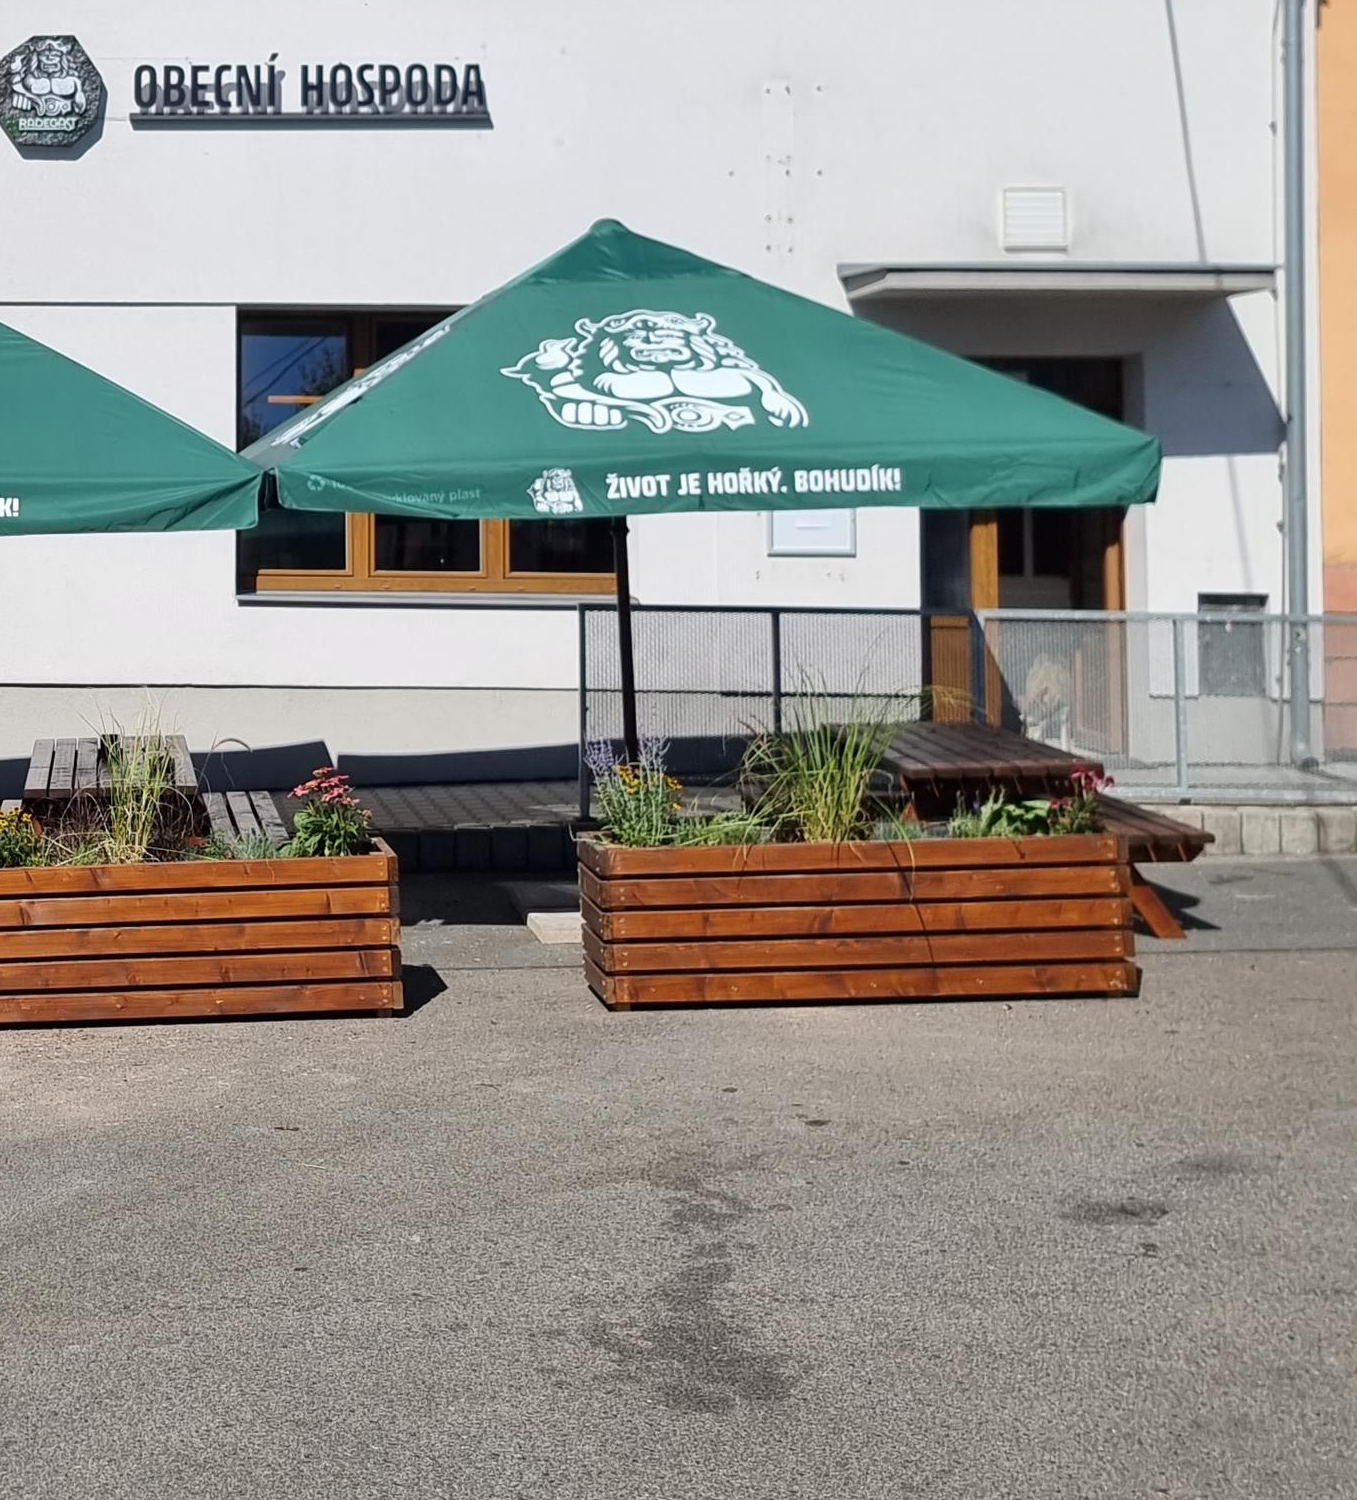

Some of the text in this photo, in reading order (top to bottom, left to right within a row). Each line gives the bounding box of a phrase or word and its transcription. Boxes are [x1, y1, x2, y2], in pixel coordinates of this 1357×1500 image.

[133, 53, 486, 108] OBECNÍ HOSPODA
[18, 117, 79, 132] RADEGAST
[606, 463, 901, 499] ŽIVOT JE HOŘKÝ. BOHUDÍK!
[449, 487, 481, 503] plast
